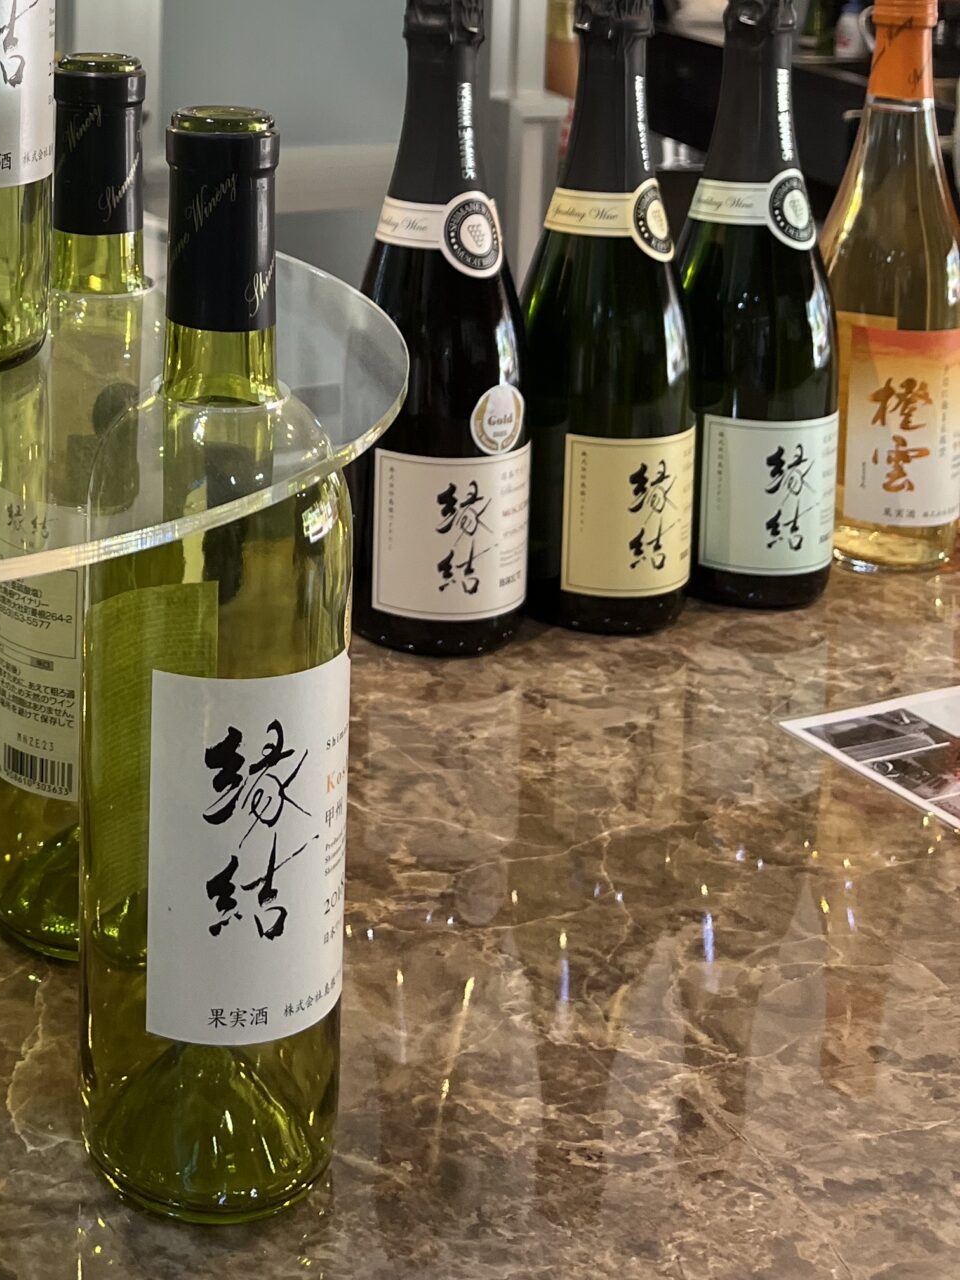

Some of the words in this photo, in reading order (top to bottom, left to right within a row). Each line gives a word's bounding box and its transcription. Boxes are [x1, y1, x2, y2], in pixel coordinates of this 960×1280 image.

[64, 104, 103, 154] Winery
[185, 172, 240, 233] Winery
[589, 207, 620, 221] Wine
[487, 413, 513, 426] Gold
[868, 377, 933, 493] 橙雲
[628, 459, 682, 571] 縁結
[764, 443, 821, 553] 縁結
[434, 480, 499, 595] 縁結
[325, 768, 346, 794] Kos
[202, 719, 320, 942] 縁結
[208, 1006, 269, 1029] 果実酒
